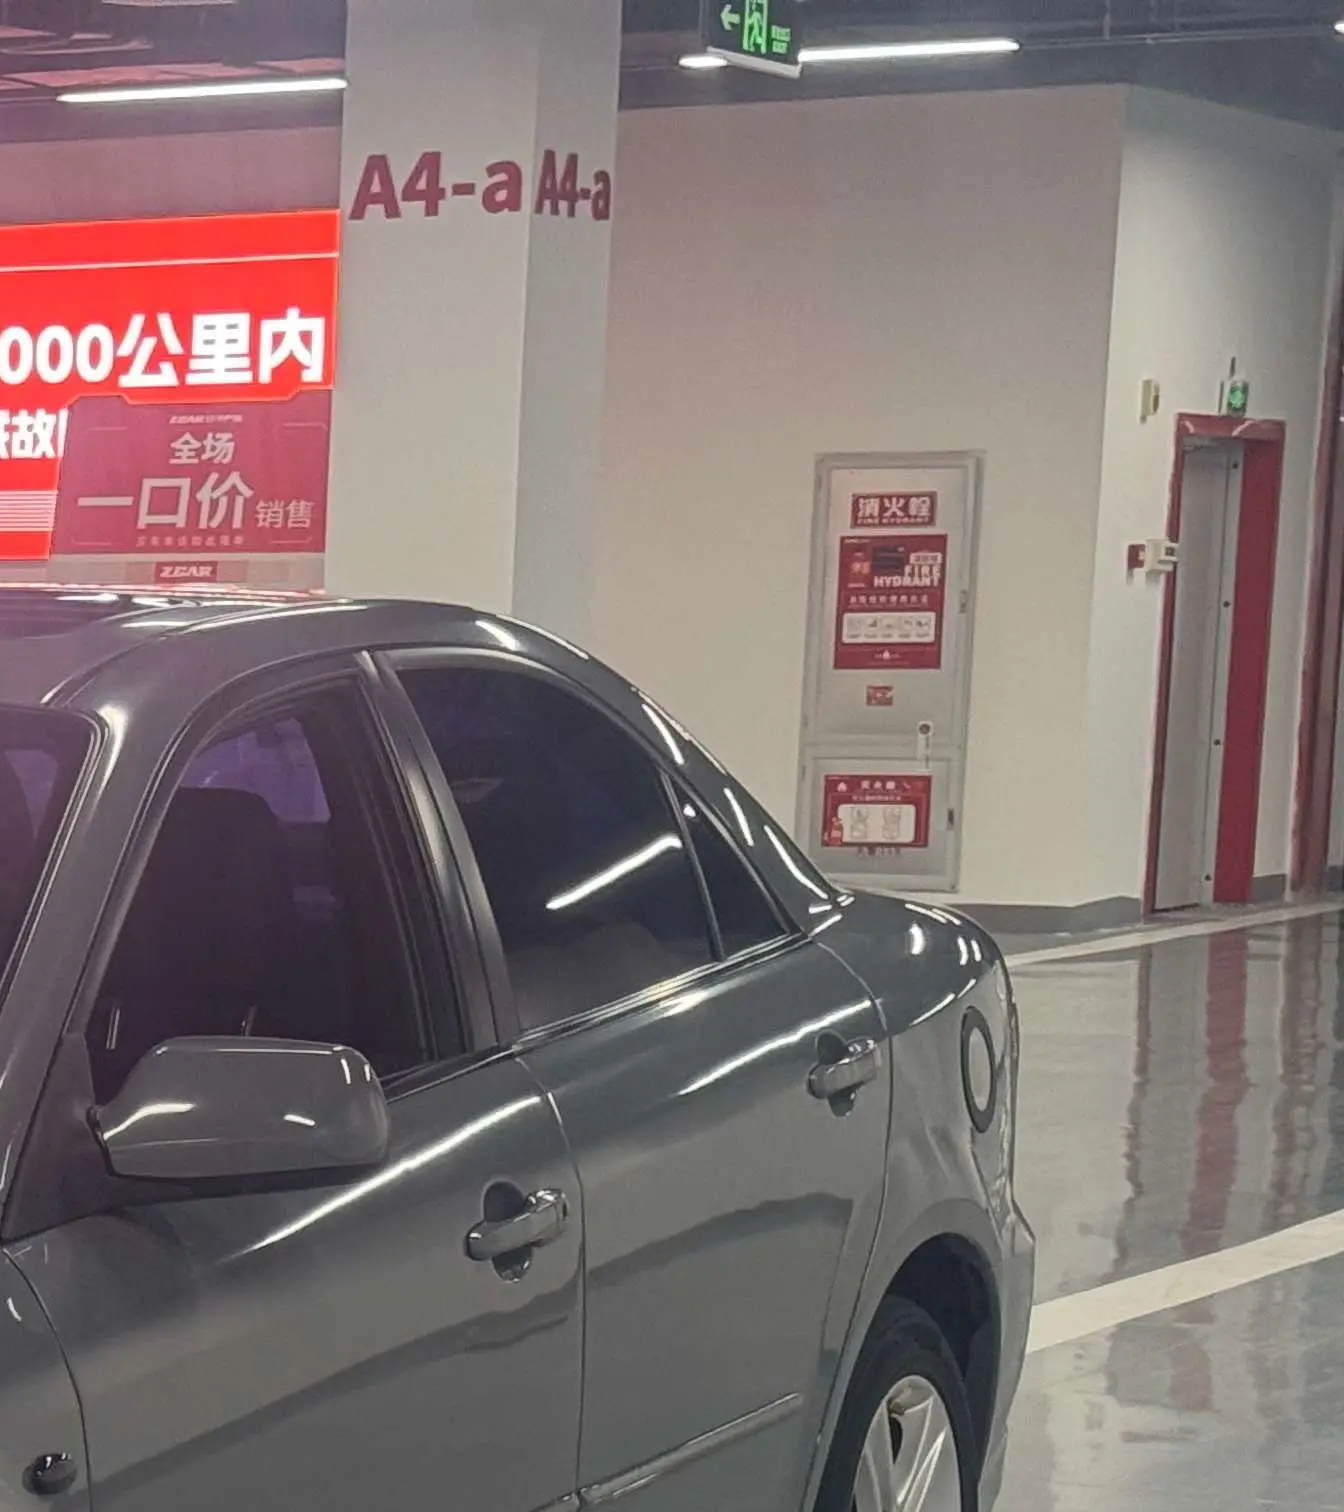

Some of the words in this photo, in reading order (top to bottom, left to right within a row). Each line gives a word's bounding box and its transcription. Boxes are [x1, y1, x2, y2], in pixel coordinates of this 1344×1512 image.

[348, 151, 523, 214] A4-a
[534, 149, 611, 221] A4-a
[168, 431, 235, 465] 全场
[77, 471, 255, 530] 一口价
[254, 499, 316, 529] 销售
[873, 575, 941, 588] HYDRANT
[903, 564, 941, 578] FIRE
